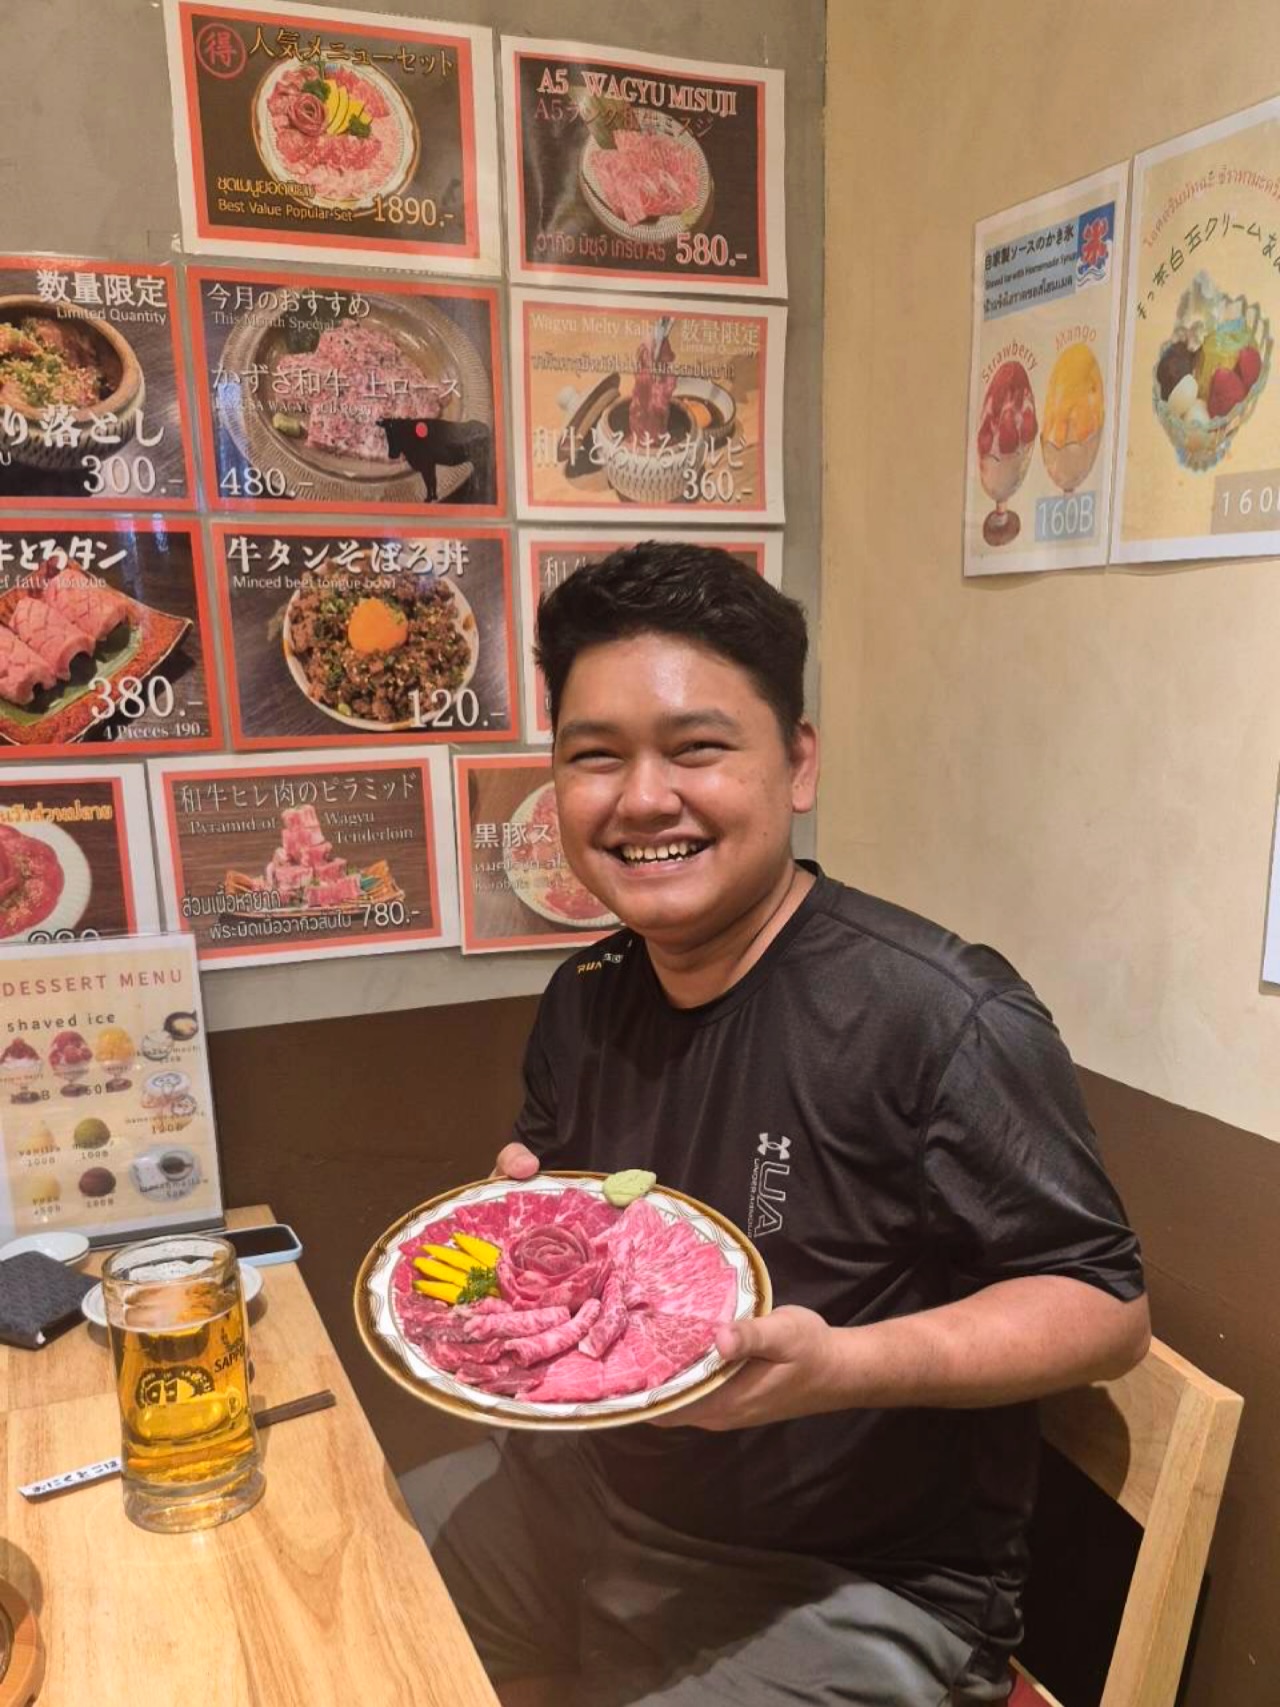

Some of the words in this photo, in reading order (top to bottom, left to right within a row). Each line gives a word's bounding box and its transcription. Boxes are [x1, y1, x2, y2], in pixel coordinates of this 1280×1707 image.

[203, 31, 238, 70] 得
[250, 26, 454, 77] 人気メニューセット
[536, 66, 570, 95] A5
[581, 70, 666, 107] WAGYU
[668, 84, 737, 118] MISUJI
[218, 198, 246, 214] Best
[248, 201, 282, 217] Value
[285, 203, 330, 220] Popular
[333, 207, 353, 222] Set
[373, 195, 454, 228] 1890.-
[646, 241, 666, 262] A5
[675, 232, 748, 268] 580.-
[36, 269, 168, 308] 数量限定
[206, 282, 371, 318] 今月のおすすめ
[56, 306, 106, 321] Limited
[109, 308, 167, 326] Quantity
[211, 310, 238, 325] This
[244, 313, 285, 328] Month
[288, 316, 335, 331] Special
[680, 319, 760, 347] 数量限定
[1055, 325, 1097, 351] Mango
[982, 340, 1037, 383] Strawberry
[211, 363, 351, 398] かずさ和牛
[362, 373, 461, 399] 上ロース
[532, 425, 748, 470] 和牛とろけるカルビ
[81, 454, 183, 495] 300.-
[219, 467, 314, 498] 480.-
[682, 469, 753, 503] 360.-
[1222, 486, 1280, 516] 160
[227, 536, 470, 577] 牛タンそぼろ丼
[15, 575, 50, 591] fatty
[233, 575, 282, 590] Minced
[285, 575, 314, 590] beef
[317, 576, 361, 594] tongue
[364, 575, 397, 591] bowl
[87, 675, 204, 720] 380.-
[407, 688, 506, 729] 120.-
[117, 724, 170, 740] Pieces
[180, 773, 419, 814] 和牛ヒレ肉のピラミッド
[189, 819, 257, 836] Pyramid
[261, 817, 278, 831] of
[323, 810, 376, 827] Wagyu
[334, 826, 415, 845] Tenderloin
[474, 821, 553, 849] 黒豚ス
[182, 885, 281, 918] ส่วนเนื้อหายาก
[359, 900, 420, 928] 780.-
[3, 974, 107, 998] DESSERT
[119, 969, 183, 989] MENU
[7, 1013, 78, 1033] shaved
[87, 1012, 116, 1026] ice
